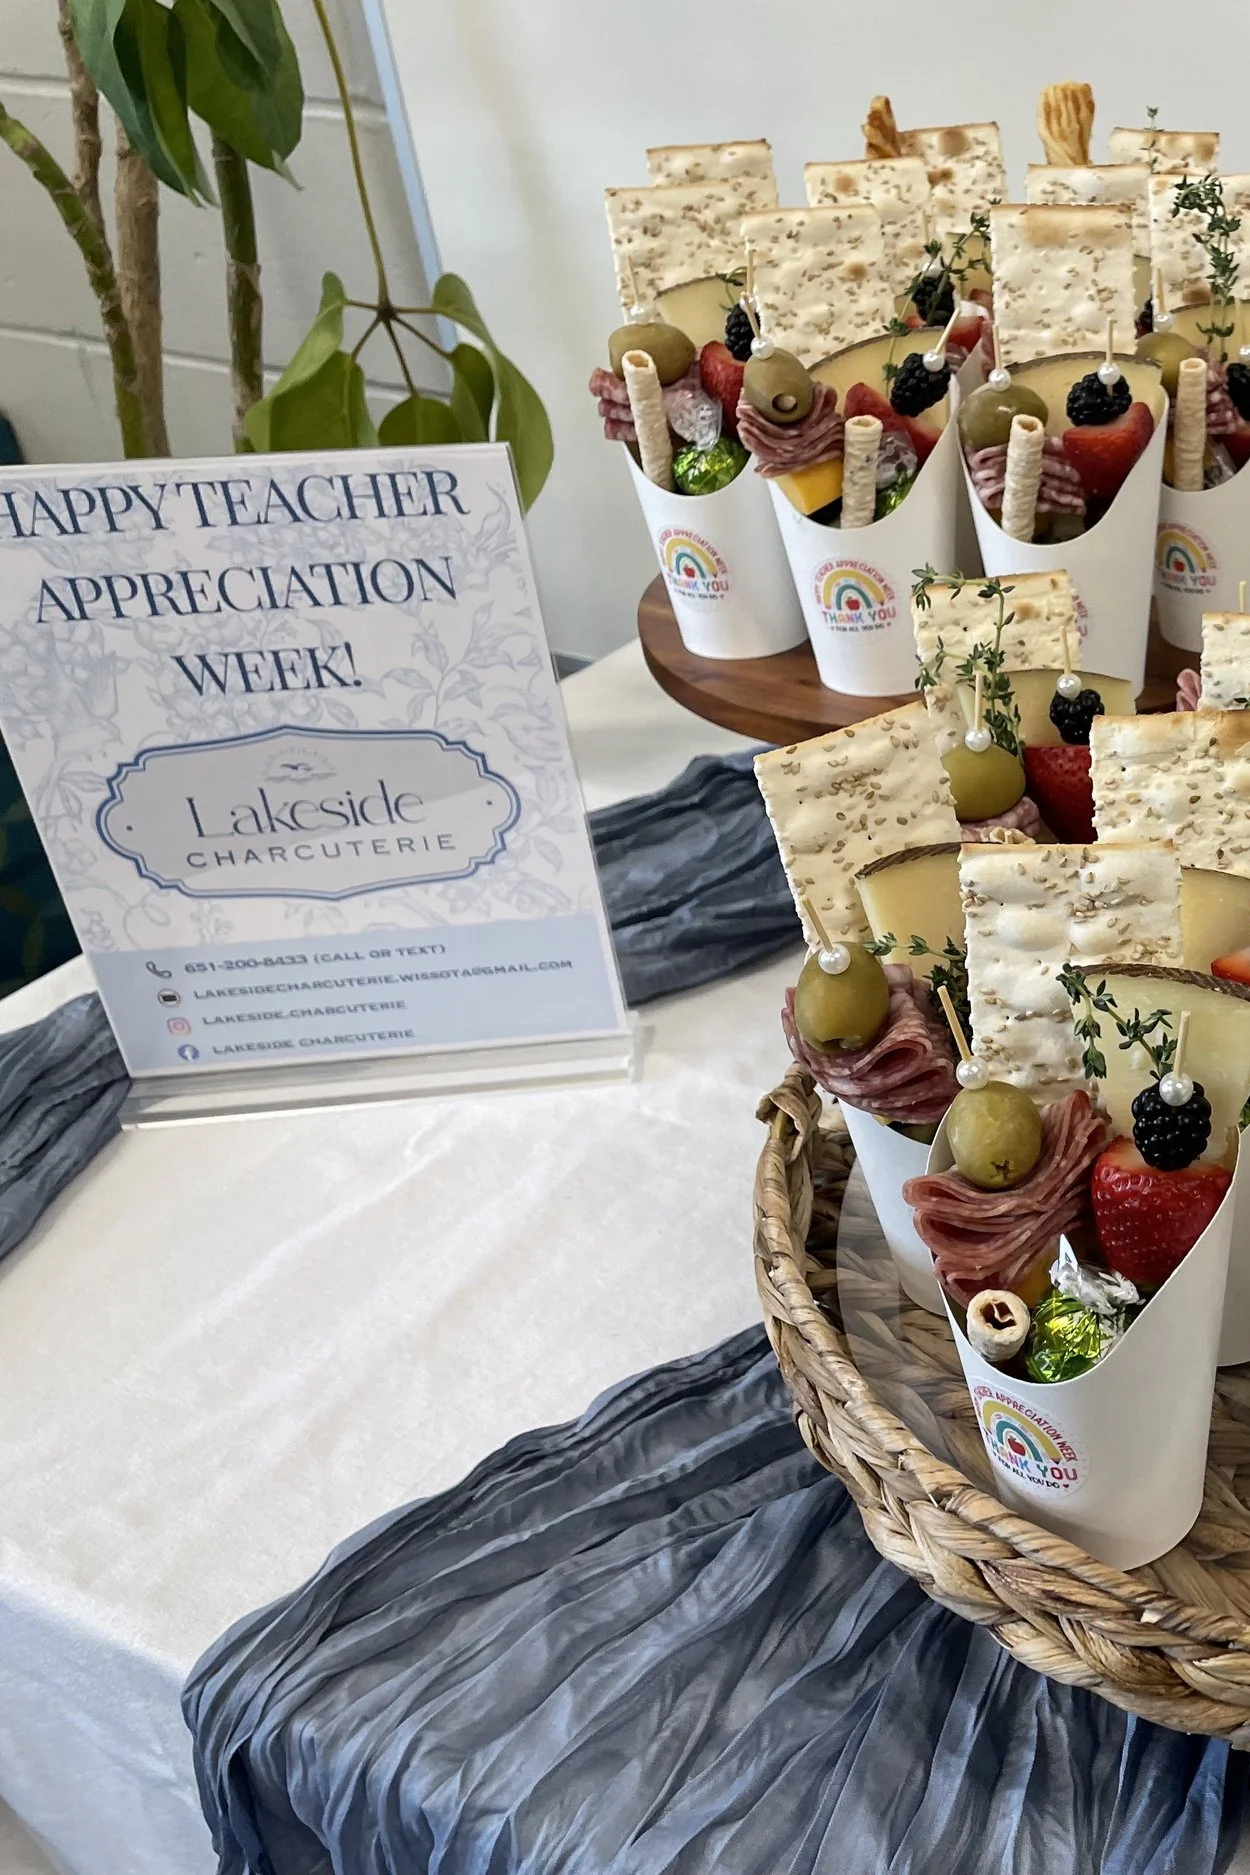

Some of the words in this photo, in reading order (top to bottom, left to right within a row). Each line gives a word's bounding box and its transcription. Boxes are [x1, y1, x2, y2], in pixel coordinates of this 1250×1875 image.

[0, 482, 170, 539] HAPPY
[175, 469, 471, 529] TEACHER
[36, 555, 458, 624] APPRECIATION
[702, 580, 729, 592] YOU
[822, 610, 864, 624] THANK
[868, 606, 896, 622] YOU
[171, 641, 363, 697] WEEK!
[186, 779, 426, 839] Lakeside
[186, 834, 457, 869] CHARCUTERIE
[184, 954, 308, 973] 651-200-8433
[313, 950, 365, 964] (CALL
[369, 949, 391, 959] OR
[396, 944, 446, 958] TEXT)
[213, 1039, 293, 1055] LAKESIDE
[298, 1029, 415, 1048] CHARCUTERIE
[995, 1392, 1063, 1441] APPRECIATION
[1056, 1440, 1078, 1462] WEEK
[984, 1429, 1031, 1473] THANK
[1036, 1463, 1078, 1481] YOU
[1027, 1475, 1045, 1486] YOU
[1045, 1480, 1060, 1489] DO
